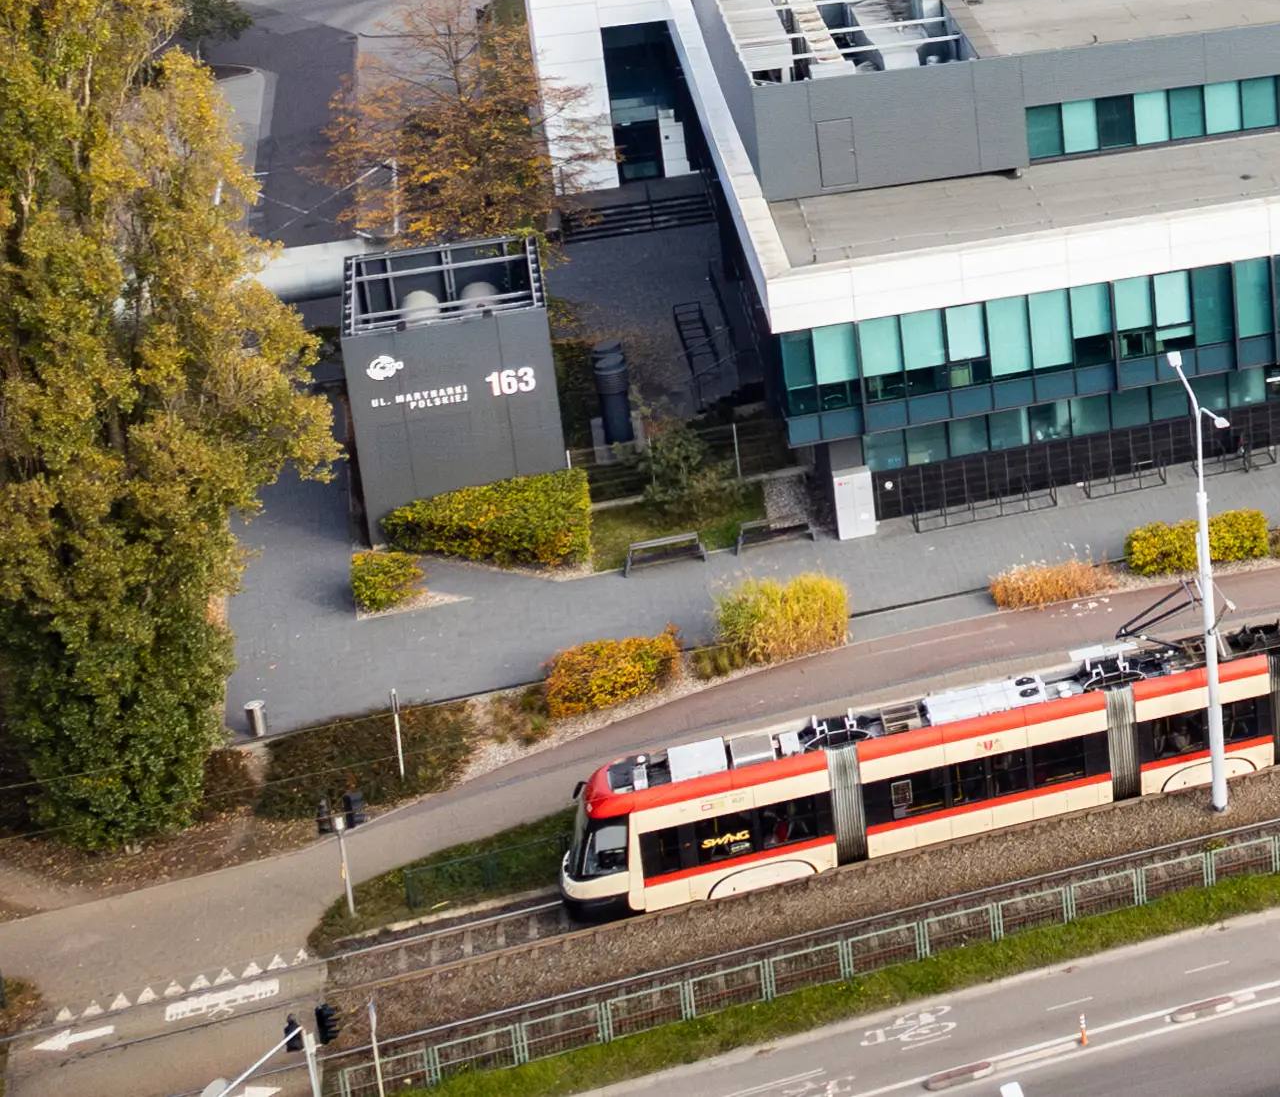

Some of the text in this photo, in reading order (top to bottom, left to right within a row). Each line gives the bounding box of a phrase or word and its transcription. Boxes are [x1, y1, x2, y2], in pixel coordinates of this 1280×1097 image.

[485, 366, 537, 397] 163
[395, 384, 468, 404] MARYNARKI
[410, 393, 469, 410] POLSKIEJ
[702, 830, 750, 850] SWING
